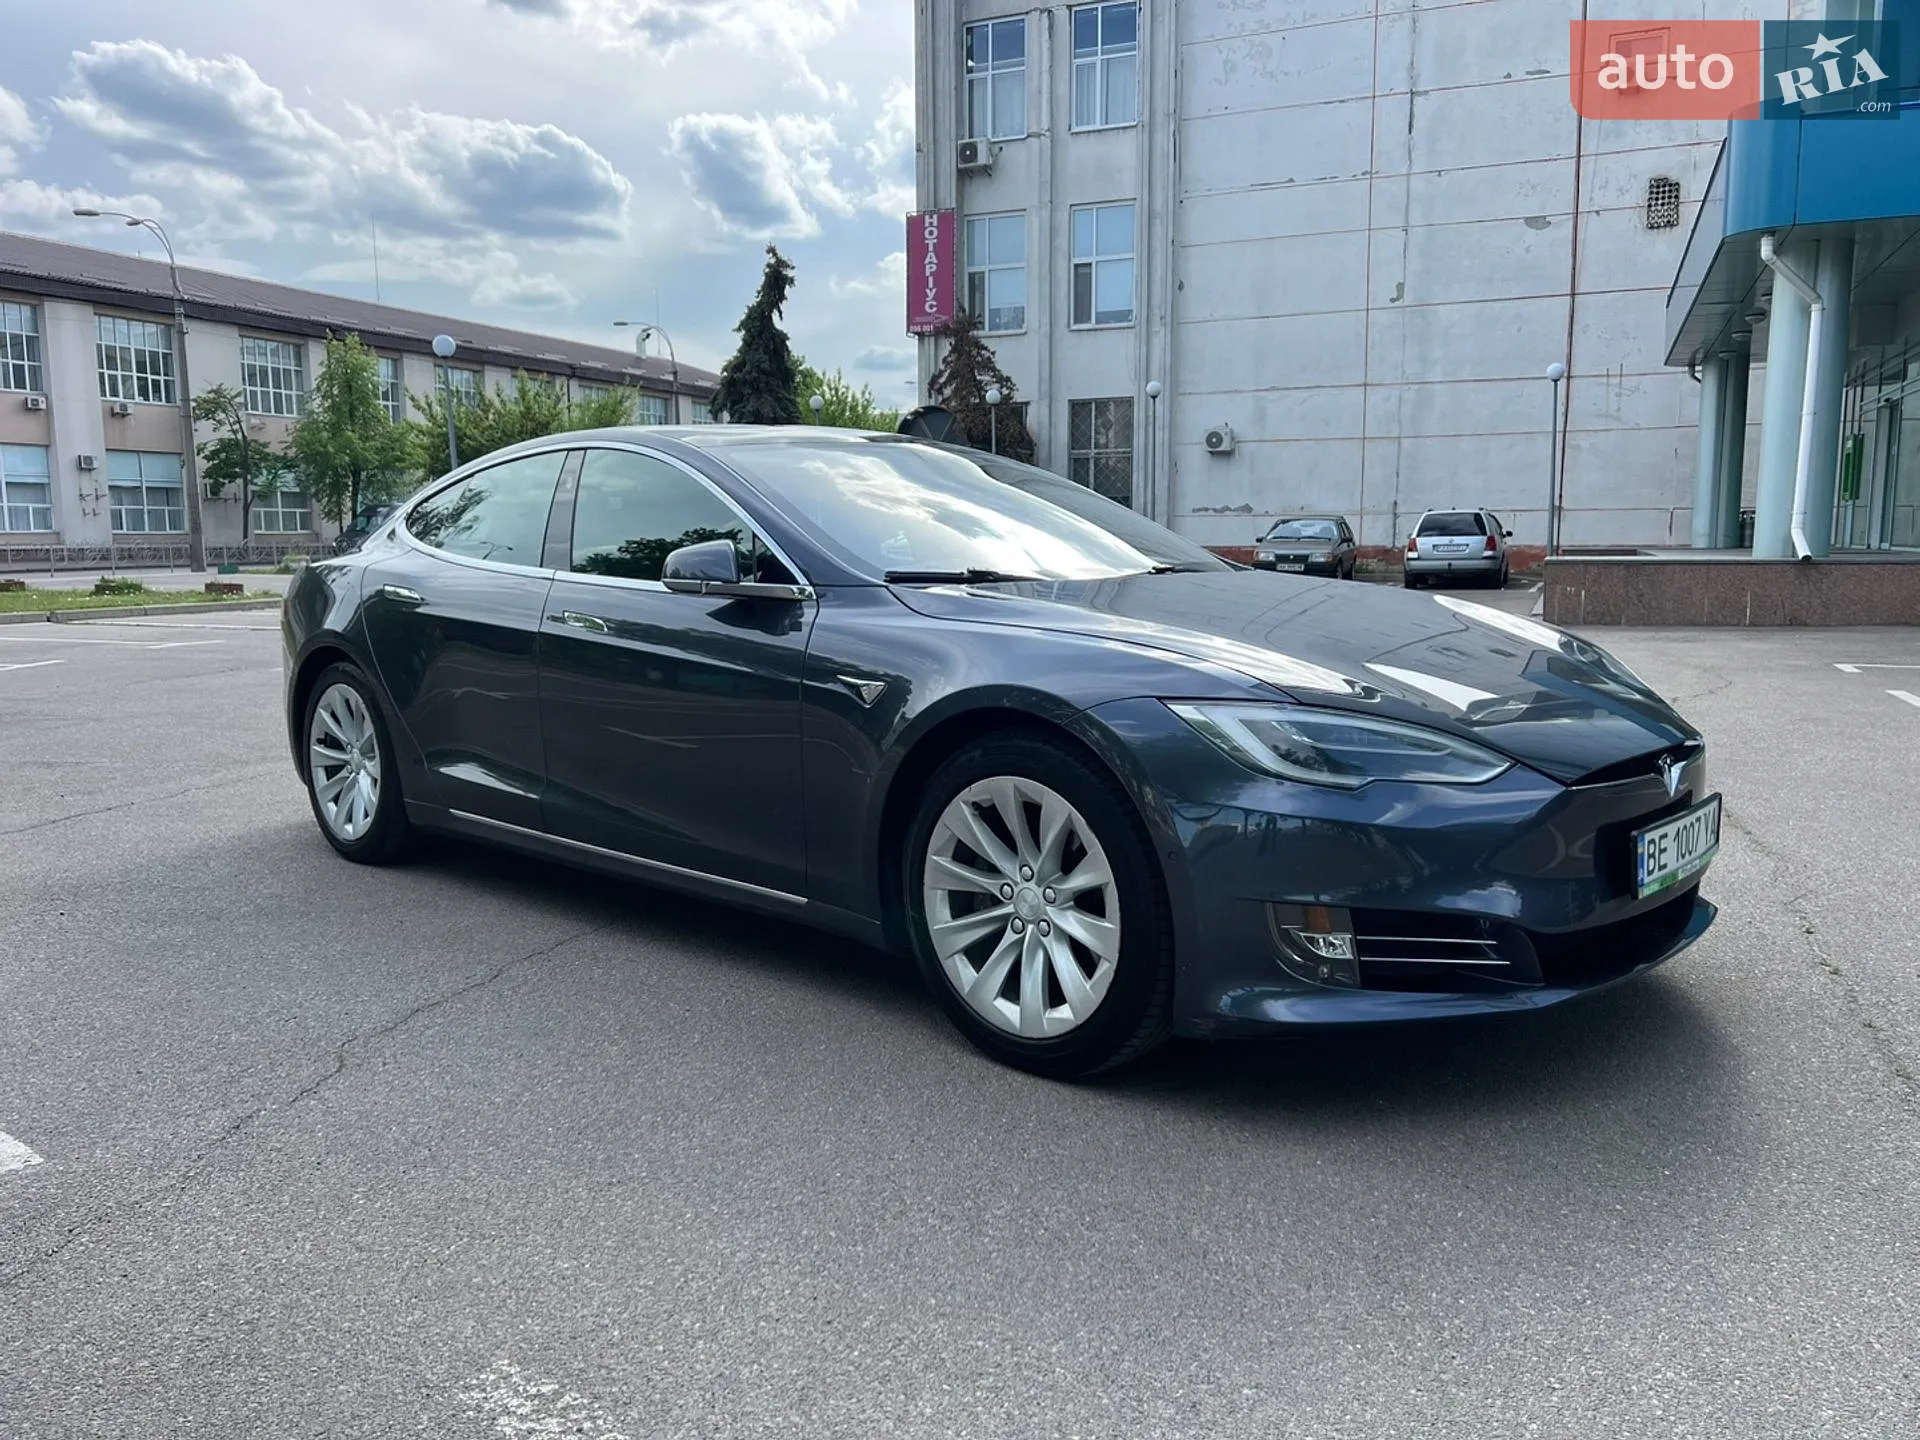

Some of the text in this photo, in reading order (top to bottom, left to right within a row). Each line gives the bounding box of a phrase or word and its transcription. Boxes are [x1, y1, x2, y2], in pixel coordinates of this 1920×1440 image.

[924, 213, 938, 313] НОТАРІУС
[1646, 832, 1668, 877] BE
[1673, 816, 1702, 863] 1007
